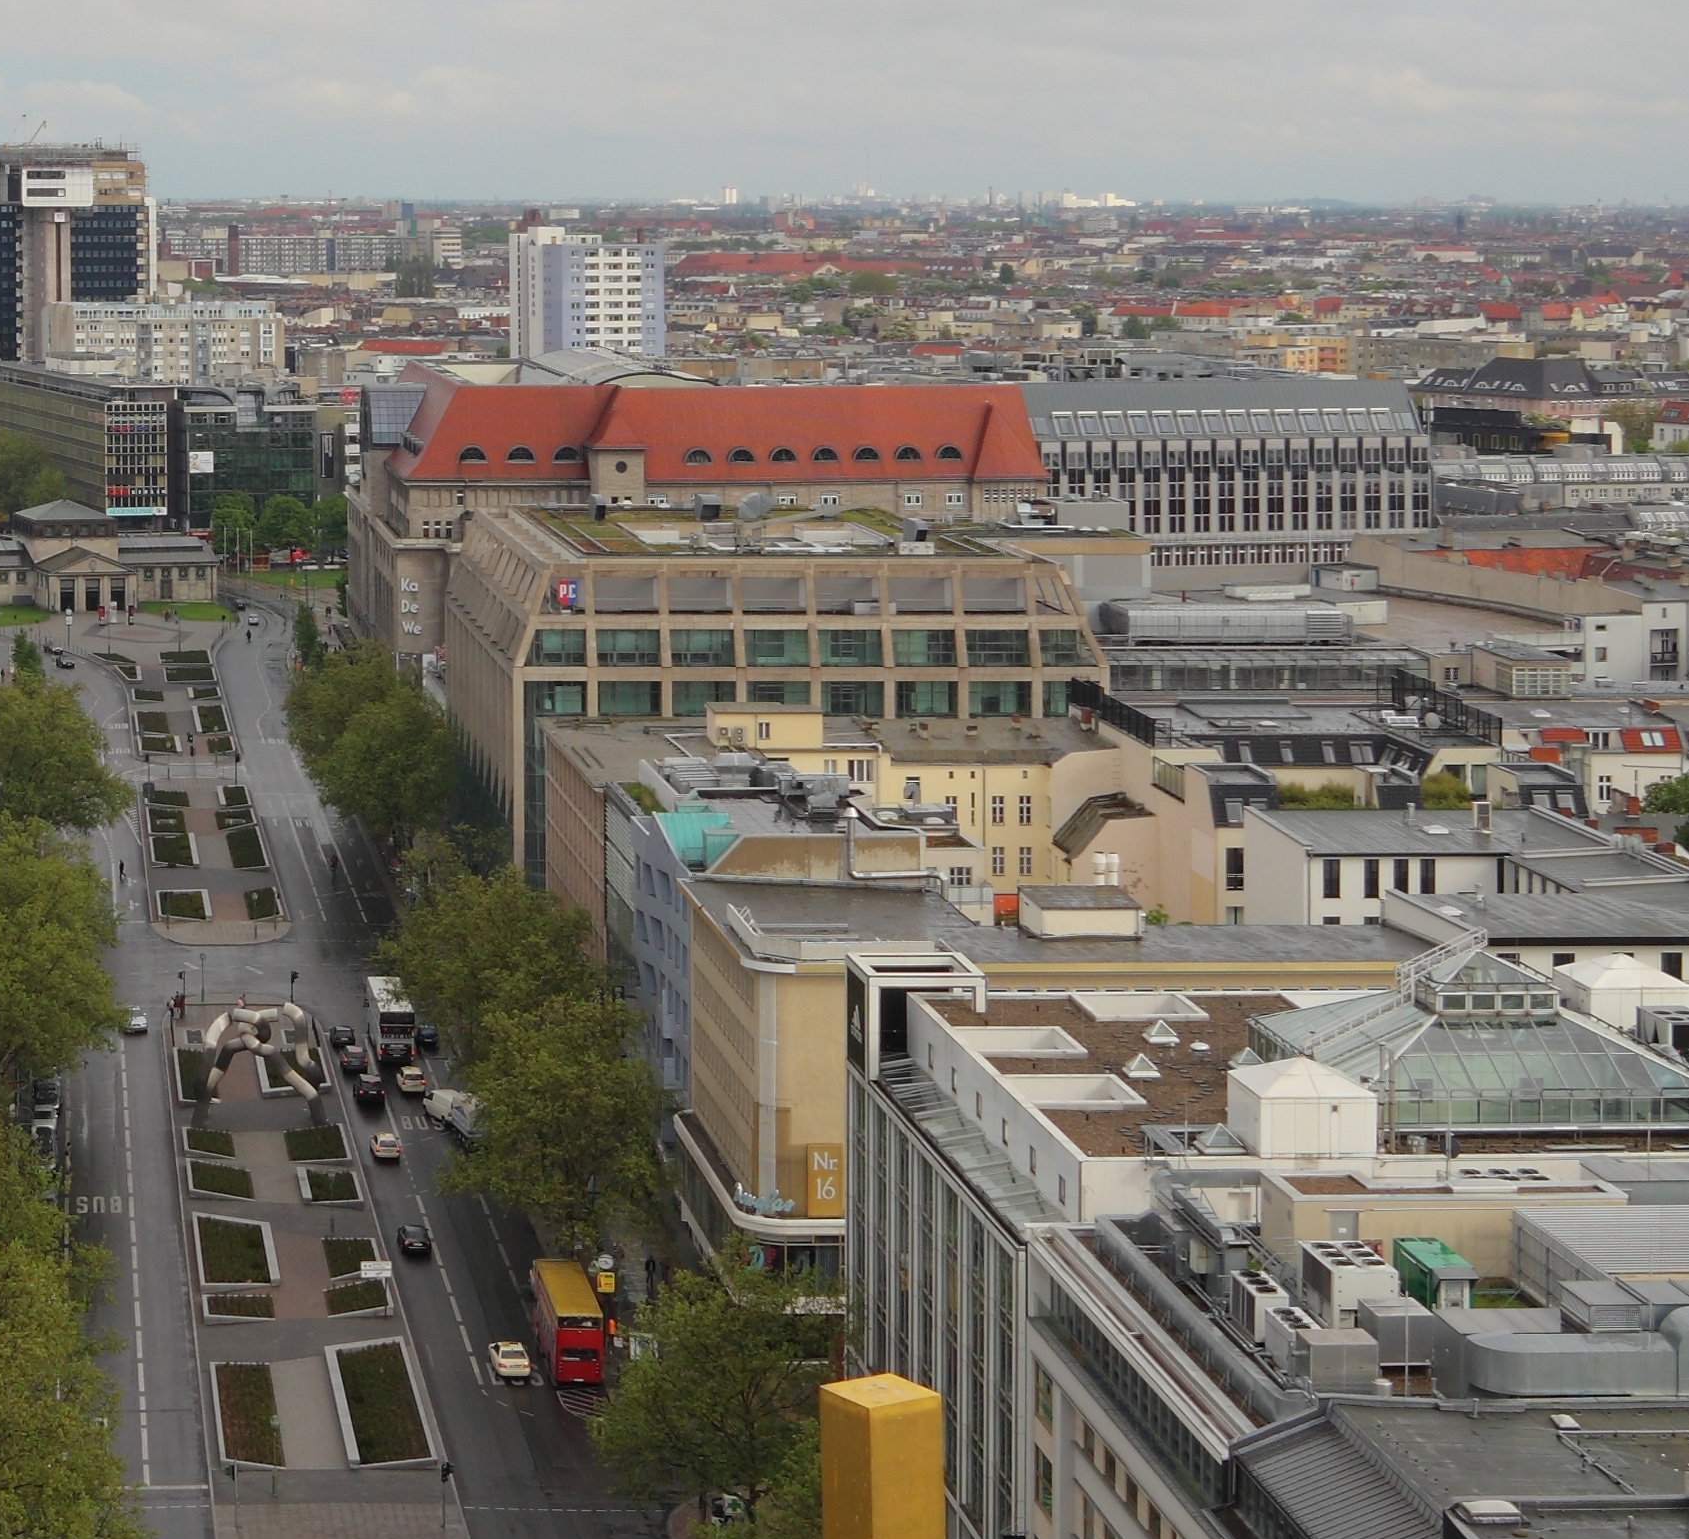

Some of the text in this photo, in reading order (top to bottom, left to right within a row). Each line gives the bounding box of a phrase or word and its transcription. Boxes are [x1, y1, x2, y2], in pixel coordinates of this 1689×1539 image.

[401, 578, 418, 592] Ka
[401, 600, 419, 613] De
[402, 621, 422, 635] We
[401, 1116, 445, 1130] BUS
[816, 1176, 836, 1200] 16
[76, 1196, 122, 1213] BUS
